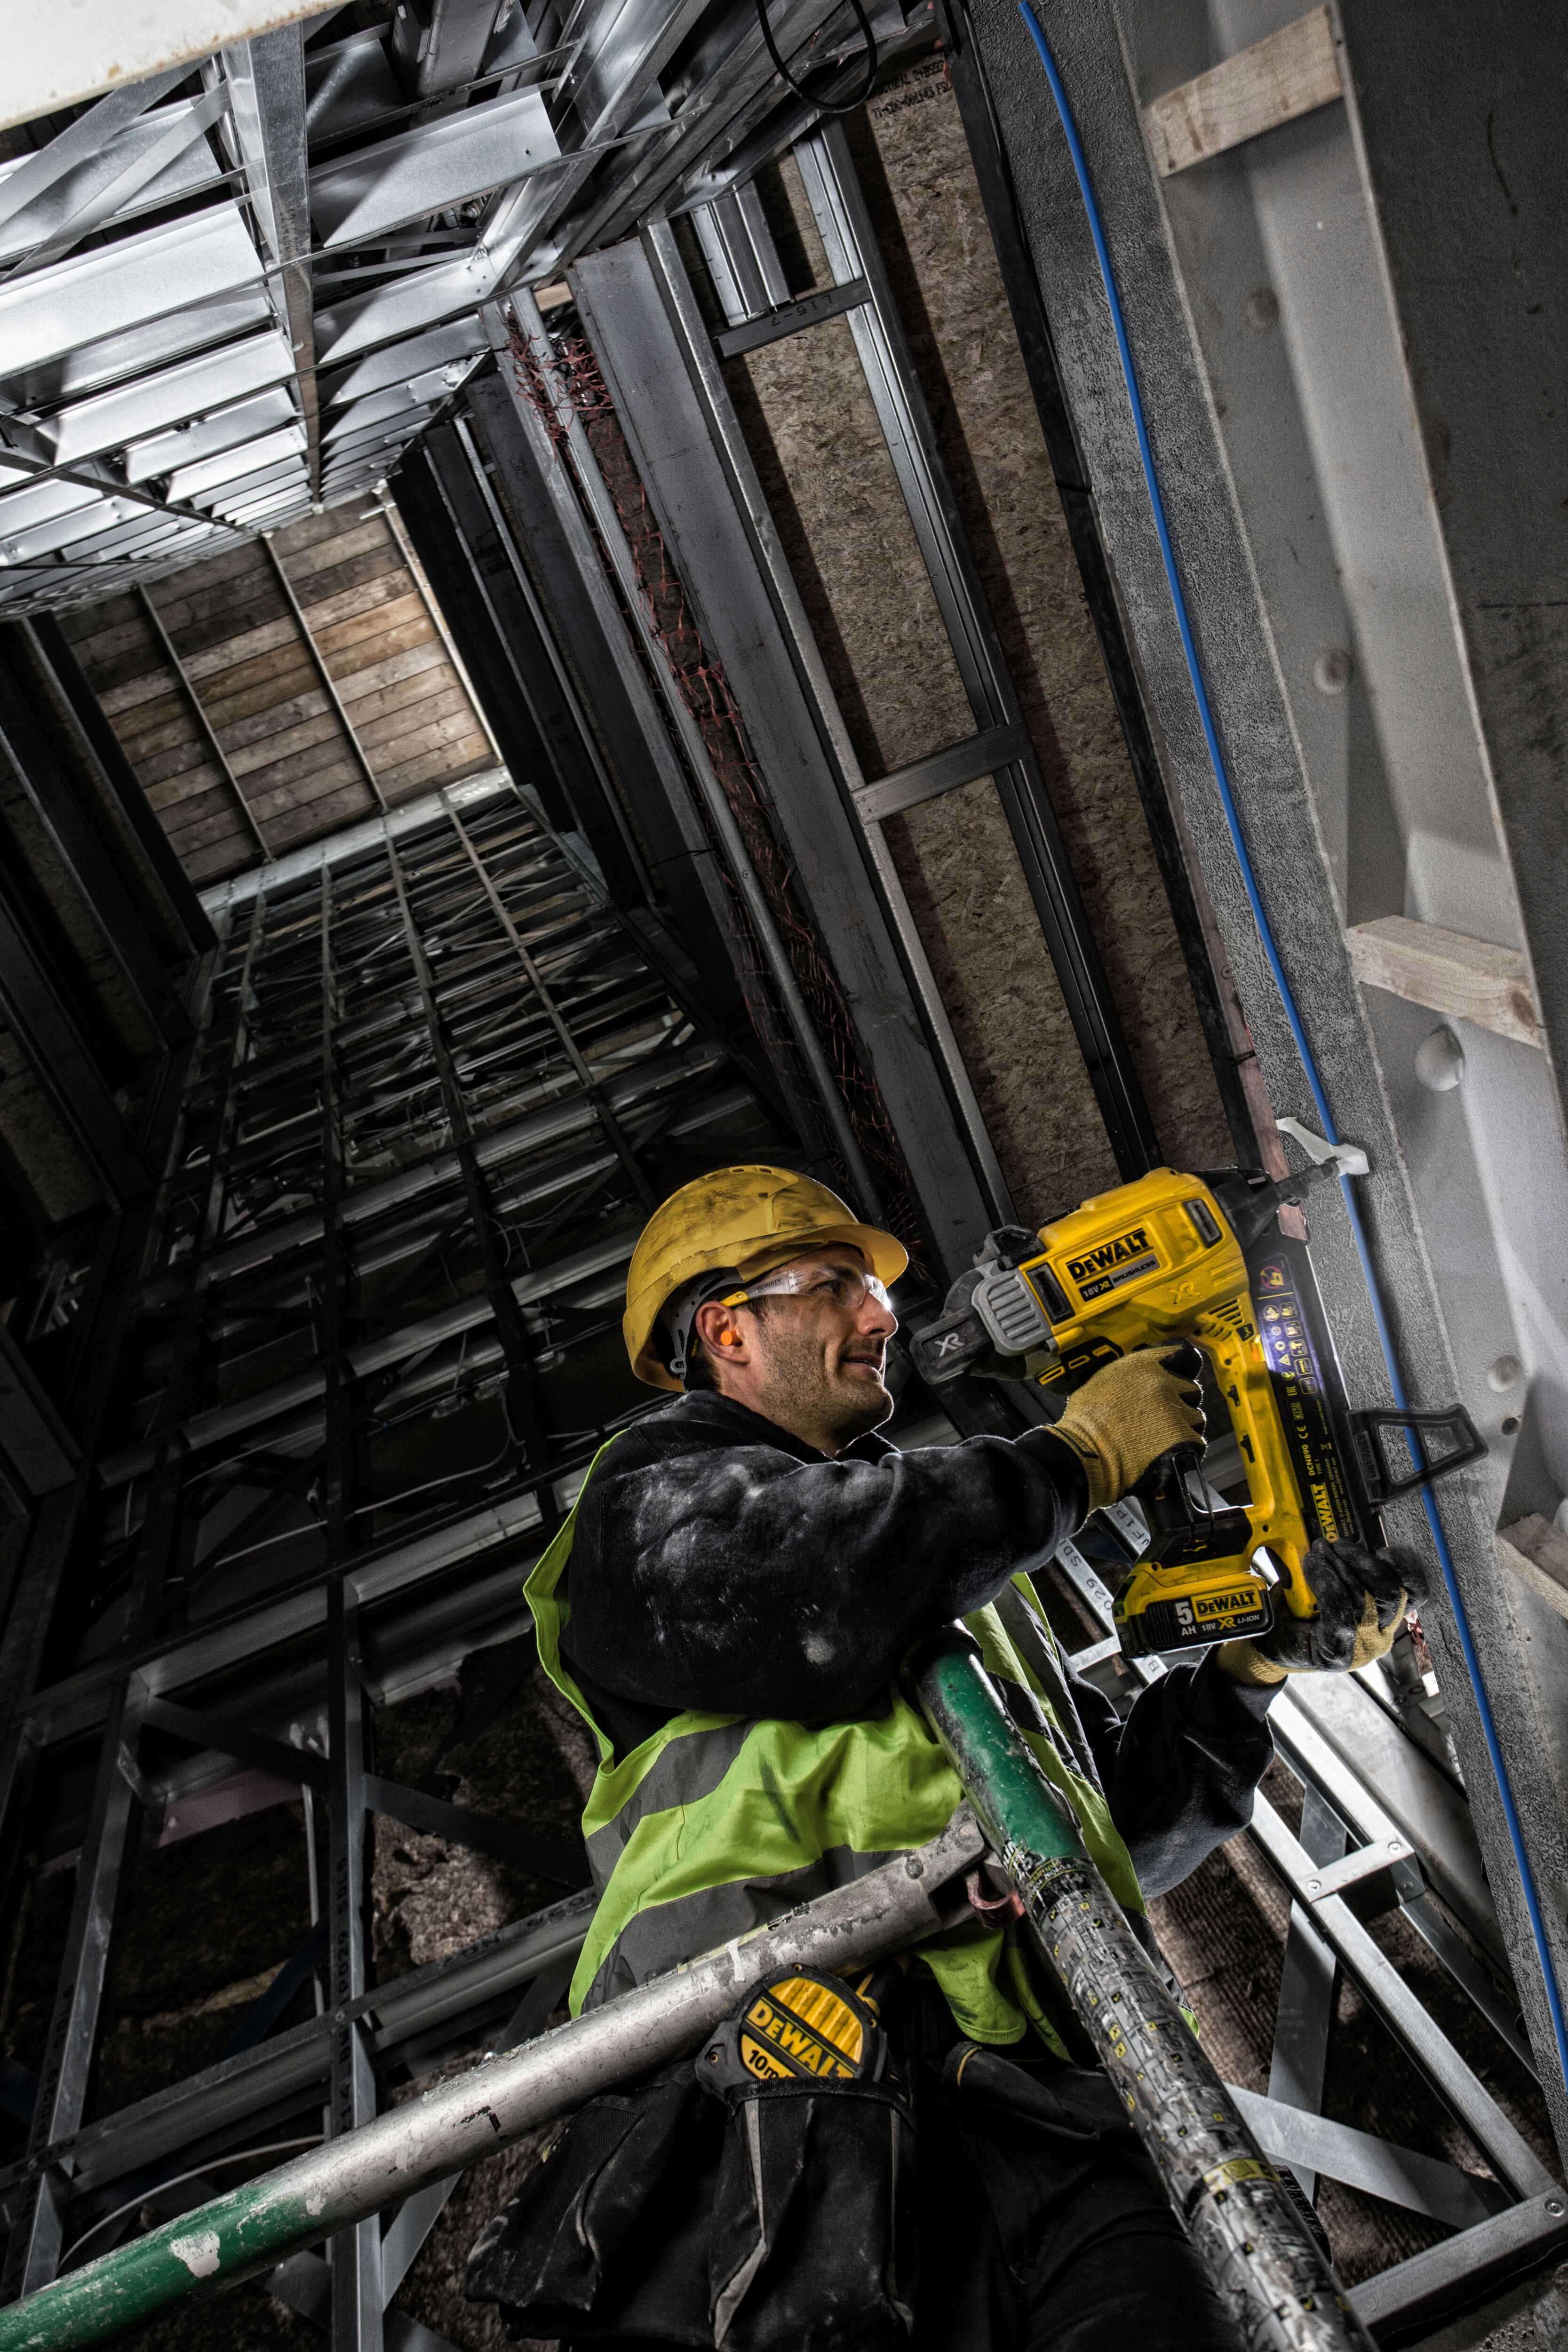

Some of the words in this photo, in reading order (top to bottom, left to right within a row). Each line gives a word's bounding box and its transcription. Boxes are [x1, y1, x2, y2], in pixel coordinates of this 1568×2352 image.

[1067, 1230, 1148, 1280] DEWALT
[1083, 1285, 1098, 1298] 18V
[1098, 1280, 1111, 1291] XR
[1113, 1259, 1156, 1284] BRUSHLESS
[934, 1332, 964, 1357] XR
[1301, 1443, 1315, 1476] DCN890
[1324, 1458, 1334, 1480] GERMANY
[1313, 1483, 1338, 1543] DEWALT
[1176, 1602, 1194, 1625] 5
[1197, 1591, 1256, 1616] DEWALT
[1181, 1626, 1196, 1637] AH
[1202, 1622, 1216, 1632] 18V
[1218, 1617, 1237, 1630] XR
[1238, 1613, 1260, 1625] LI-ION
[748, 2000, 855, 2078] DEWALT
